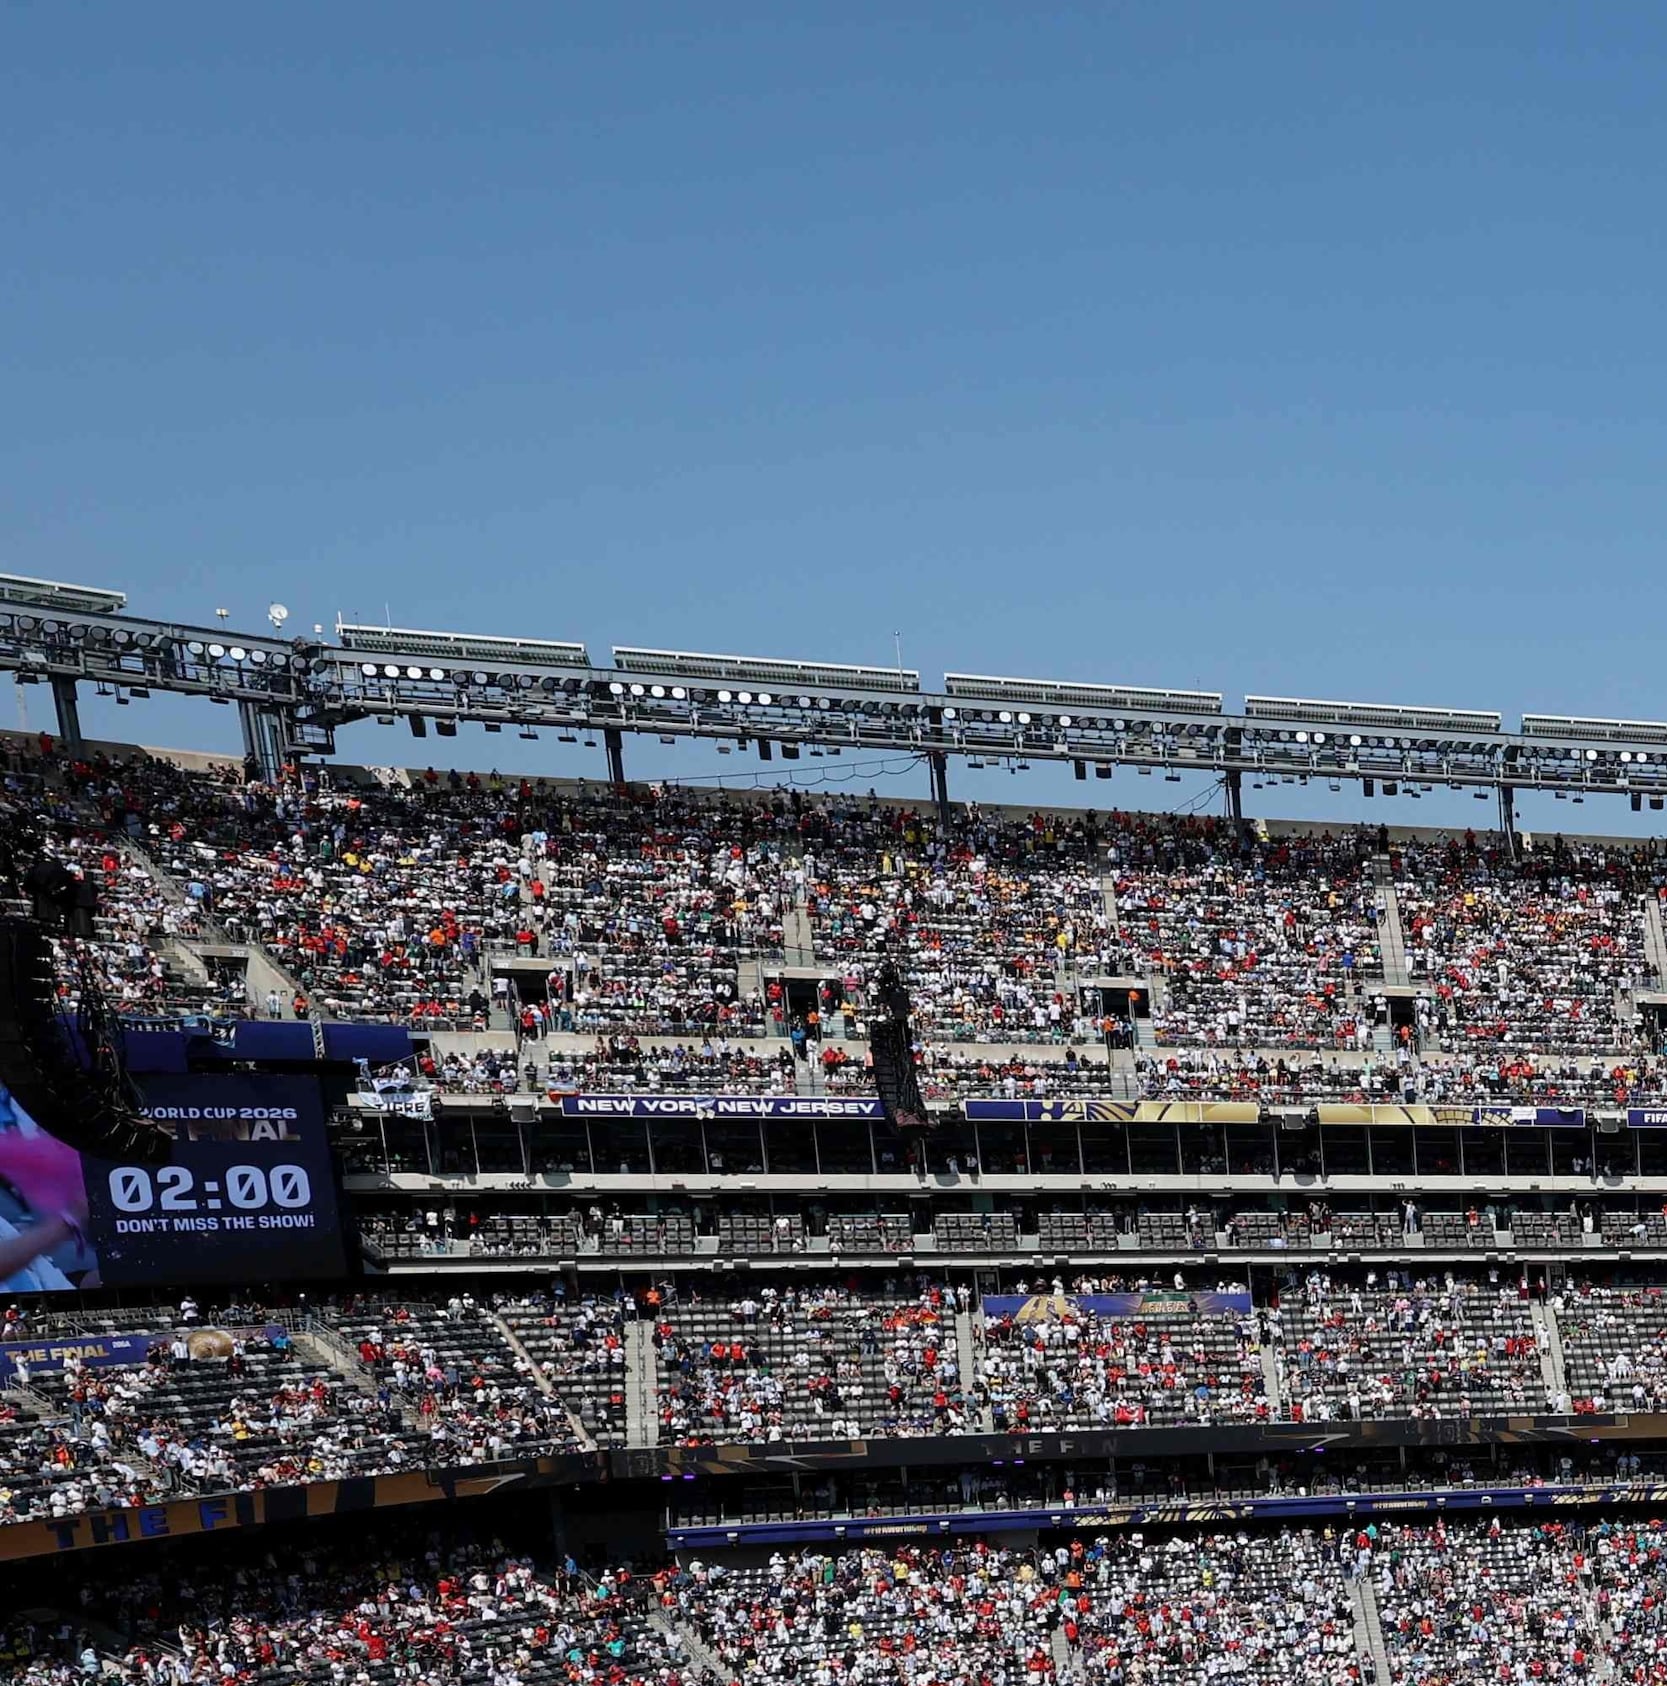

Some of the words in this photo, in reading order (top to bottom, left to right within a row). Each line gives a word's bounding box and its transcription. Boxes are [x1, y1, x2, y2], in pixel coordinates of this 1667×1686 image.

[203, 1108, 236, 1120] CUP
[239, 1107, 297, 1119] 2026
[577, 1098, 635, 1112] NEW
[717, 1099, 777, 1114] NEW
[779, 1100, 875, 1115] JERSEY
[108, 1164, 311, 1213] 02:00
[116, 1218, 168, 1234] DON'T
[174, 1217, 219, 1232] MISS
[224, 1216, 255, 1231] THE
[258, 1214, 315, 1230] SHOW!
[46, 1507, 169, 1550] THE
